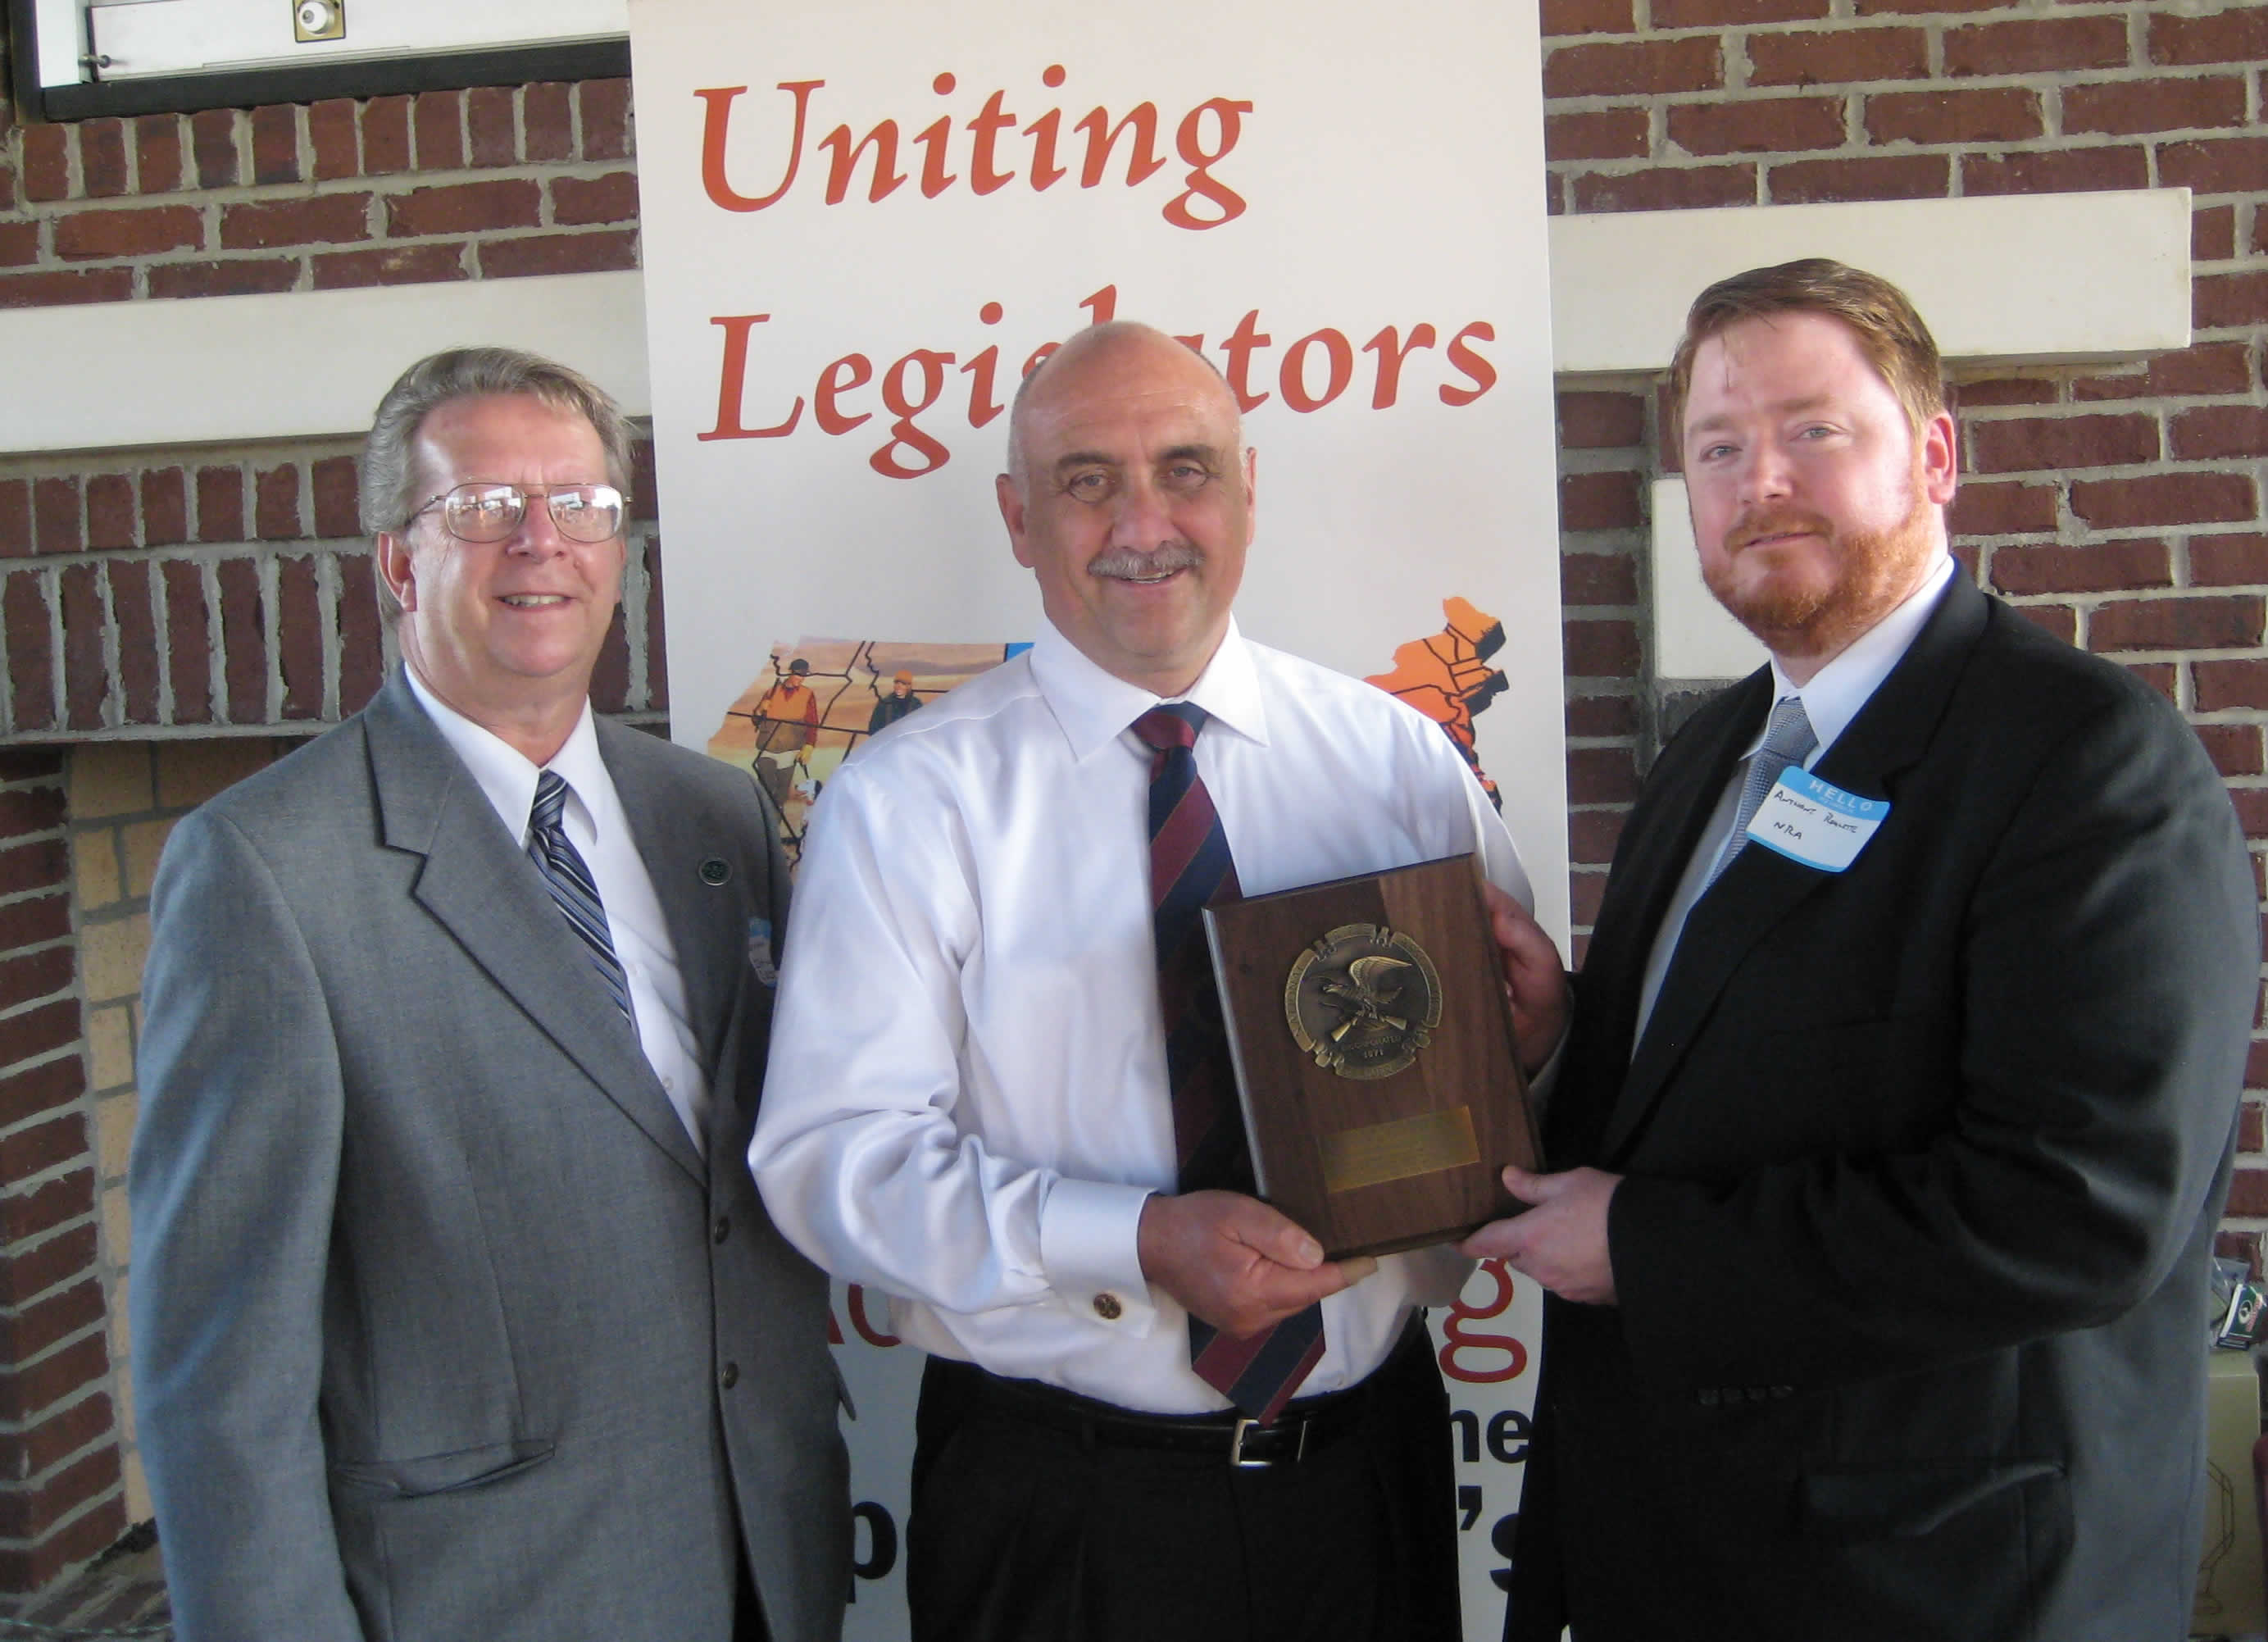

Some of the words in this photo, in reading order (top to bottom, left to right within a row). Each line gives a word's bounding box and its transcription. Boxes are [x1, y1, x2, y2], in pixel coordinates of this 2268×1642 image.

[693, 64, 1253, 230] Uniting
[697, 285, 1498, 479] Legitors
[1774, 821, 1802, 840] NRA
[1809, 780, 1874, 812] HELLO
